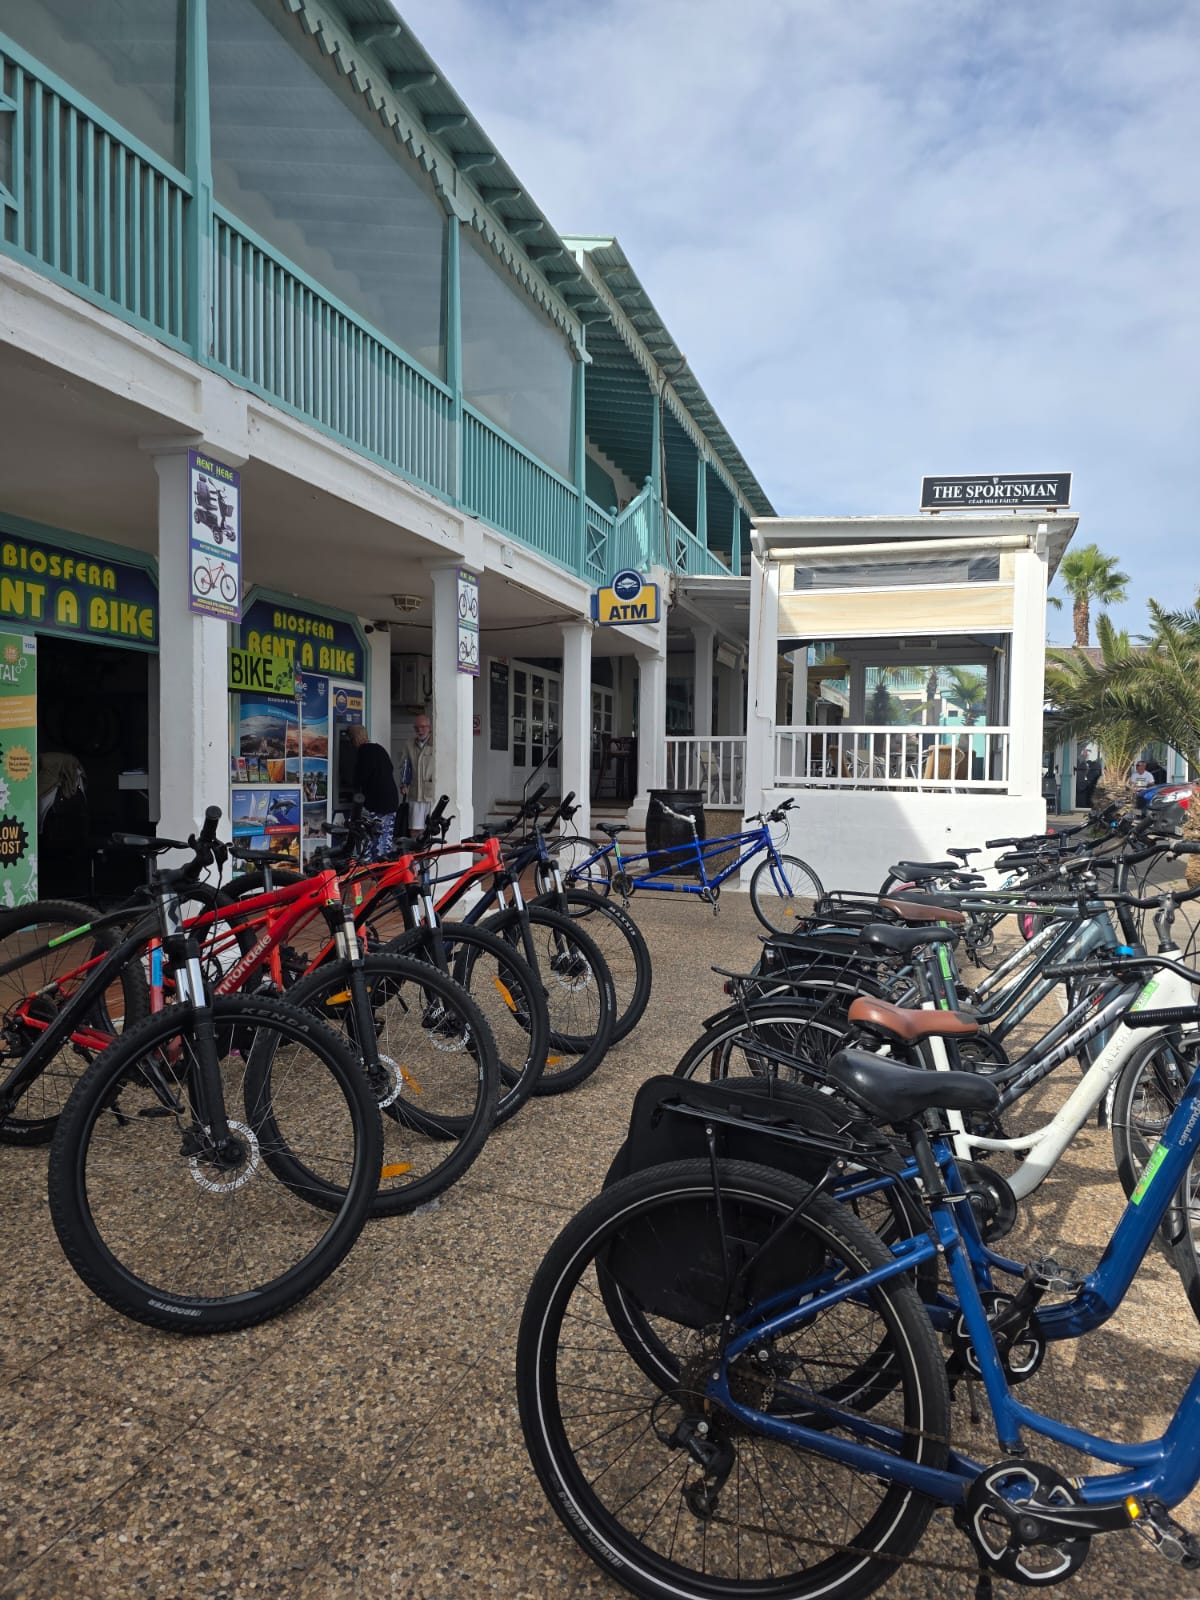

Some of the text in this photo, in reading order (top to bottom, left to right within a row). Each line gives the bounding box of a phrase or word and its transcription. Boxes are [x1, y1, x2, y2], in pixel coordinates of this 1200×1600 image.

[196, 456, 234, 481] RENT HERE
[932, 483, 1058, 498] THE SPORTSMAN
[3, 543, 115, 590] BIOSFERA
[57, 590, 78, 624] A
[90, 597, 153, 638] BIKE
[609, 603, 647, 620] ATM
[273, 611, 334, 640] BIOSFERA
[248, 631, 355, 674] RENT A BIKE
[231, 653, 274, 688] BIKE
[0, 826, 19, 840] OW
[241, 1007, 310, 1033] KENDA
